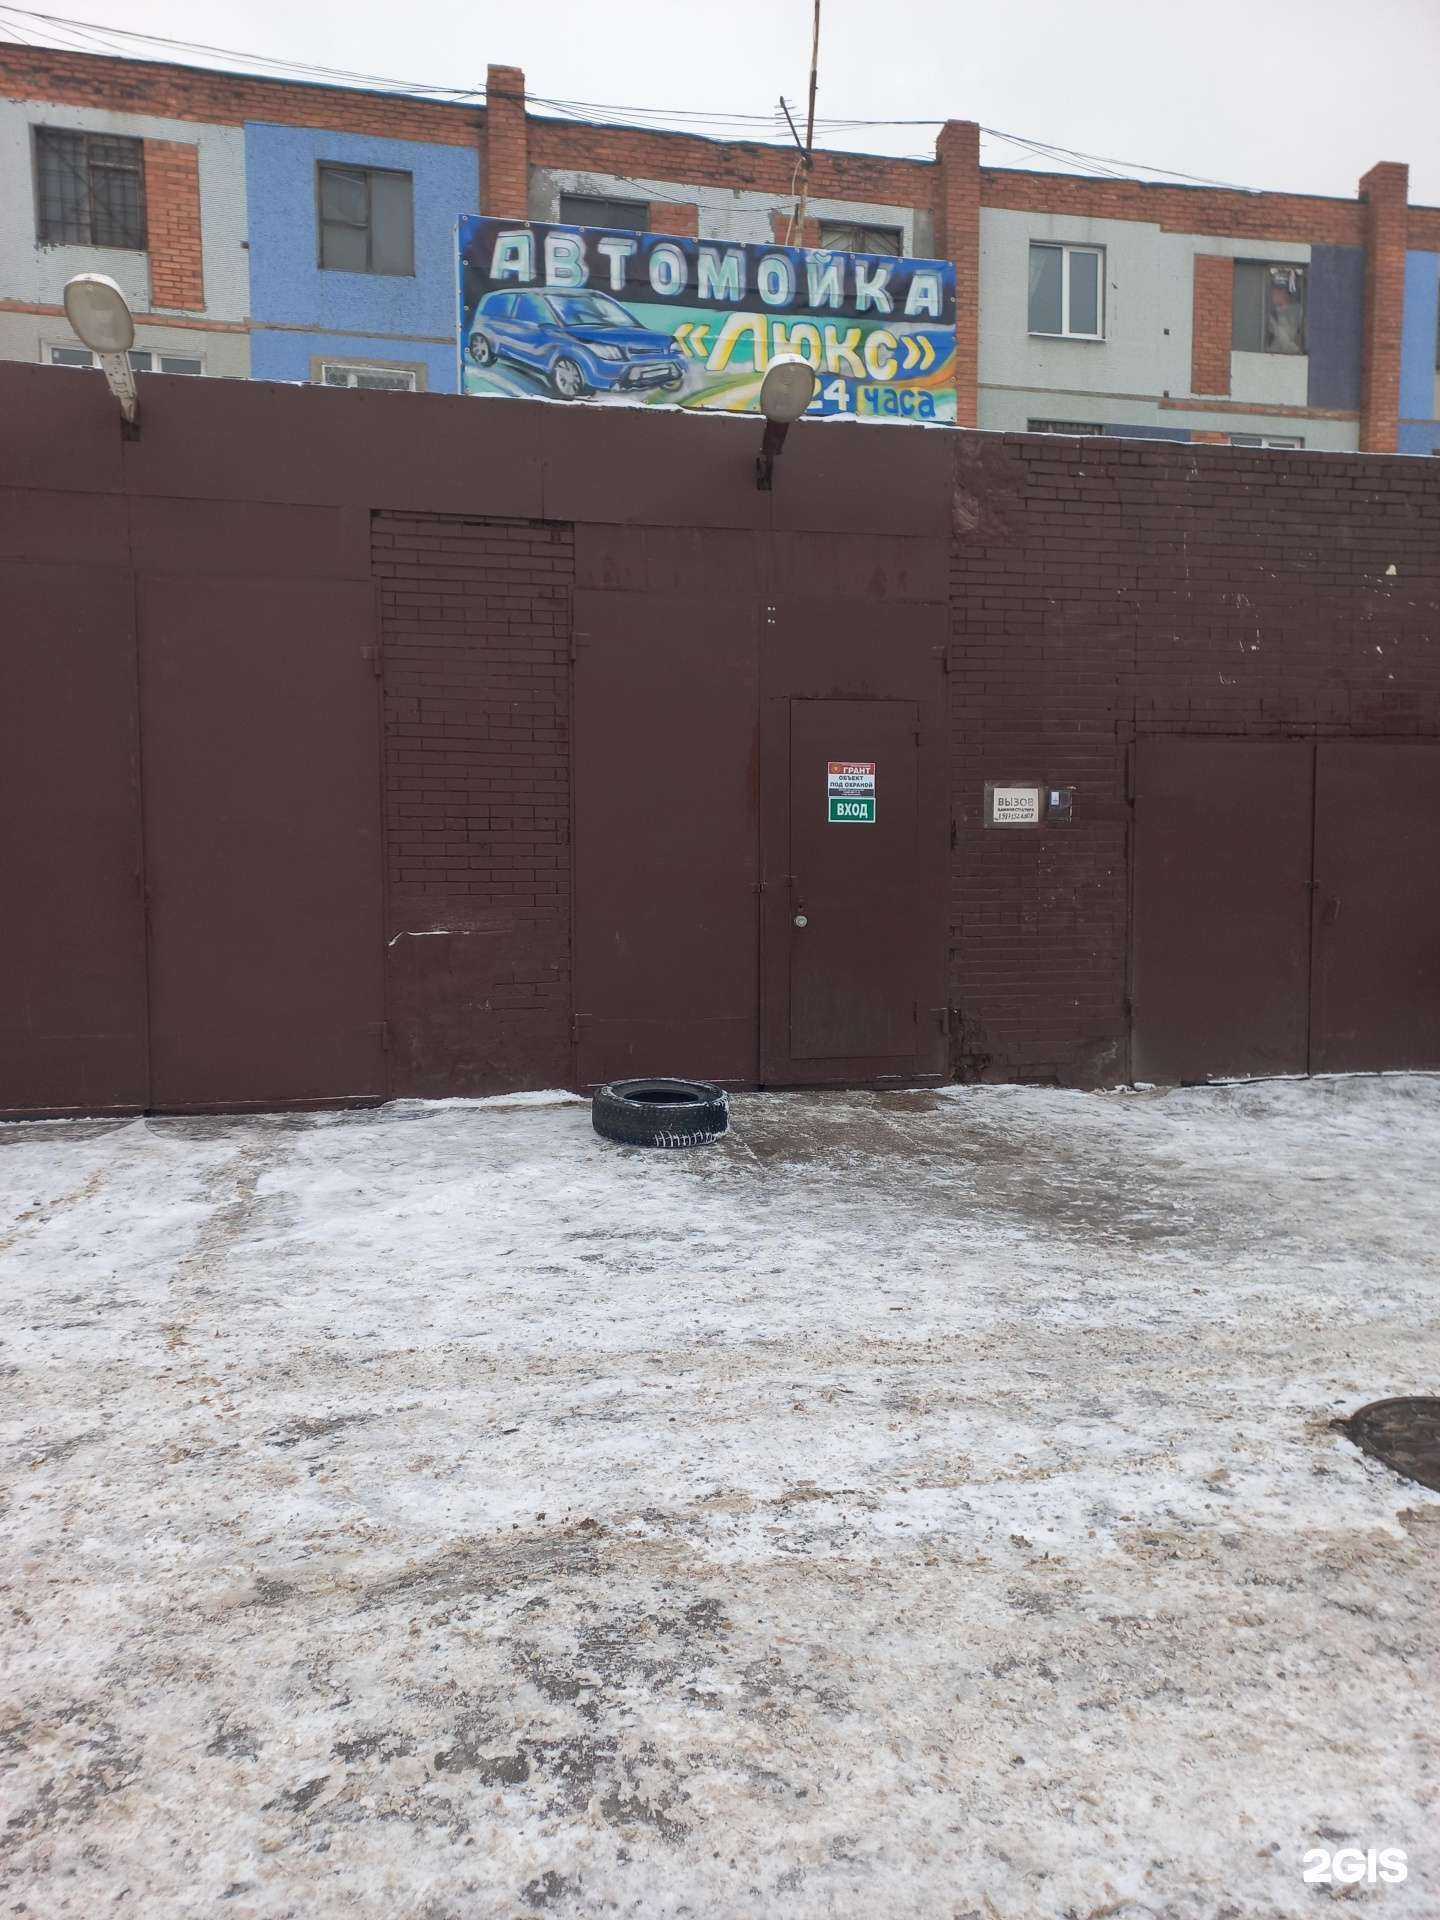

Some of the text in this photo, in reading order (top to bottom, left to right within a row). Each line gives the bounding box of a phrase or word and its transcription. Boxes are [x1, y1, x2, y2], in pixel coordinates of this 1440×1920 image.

[489, 229, 943, 317] АВТОМОЙКА
[997, 797, 1034, 807] ВЫЗОВ
[836, 803, 868, 819] ВХОД
